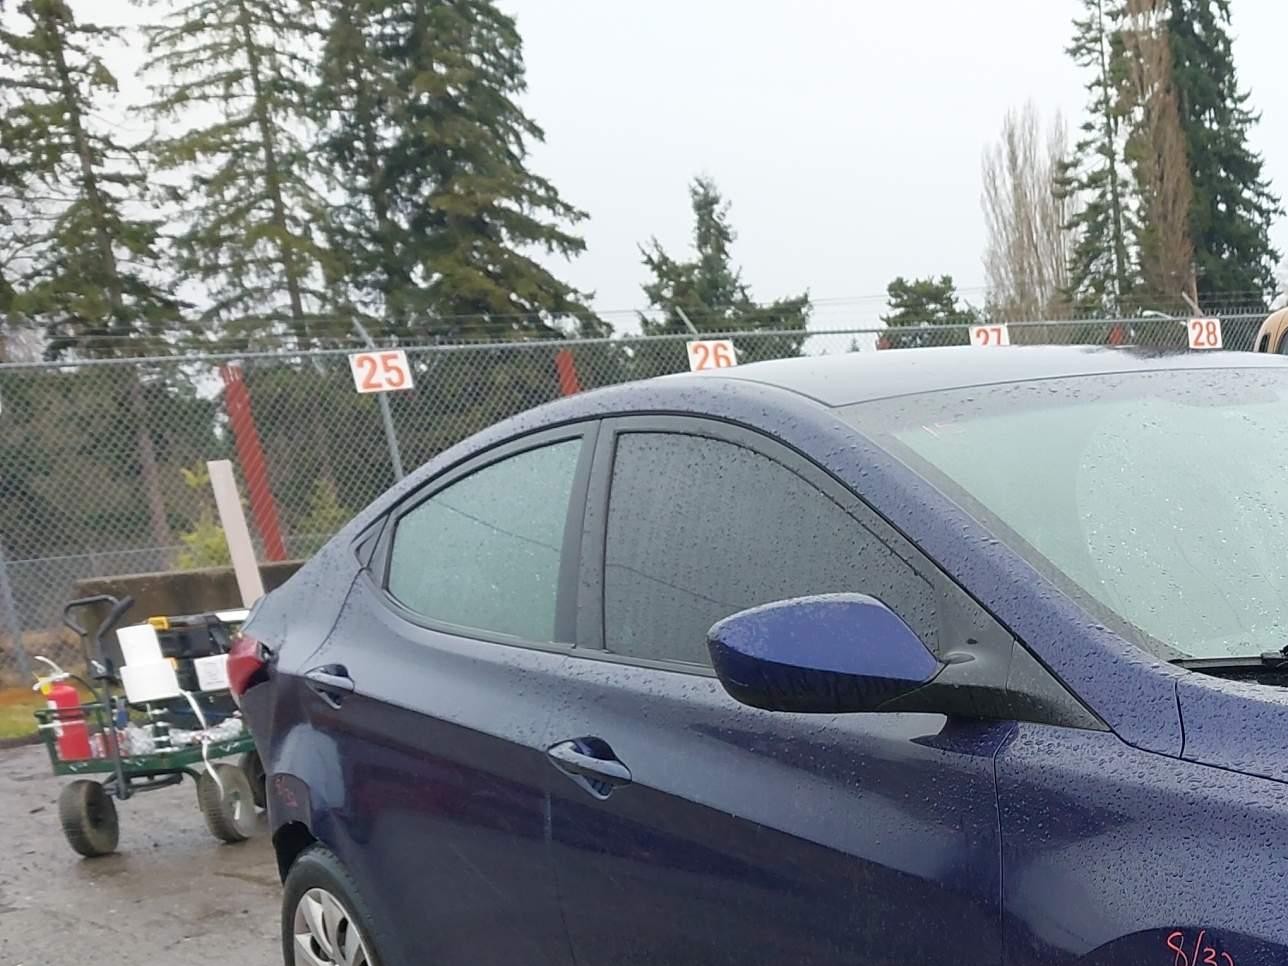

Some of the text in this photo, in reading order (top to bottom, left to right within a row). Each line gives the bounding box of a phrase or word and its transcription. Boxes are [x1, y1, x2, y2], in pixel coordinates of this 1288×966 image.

[976, 328, 1002, 346] 27
[1192, 321, 1218, 346] 28
[693, 343, 731, 371] 26
[356, 354, 405, 389] 25
